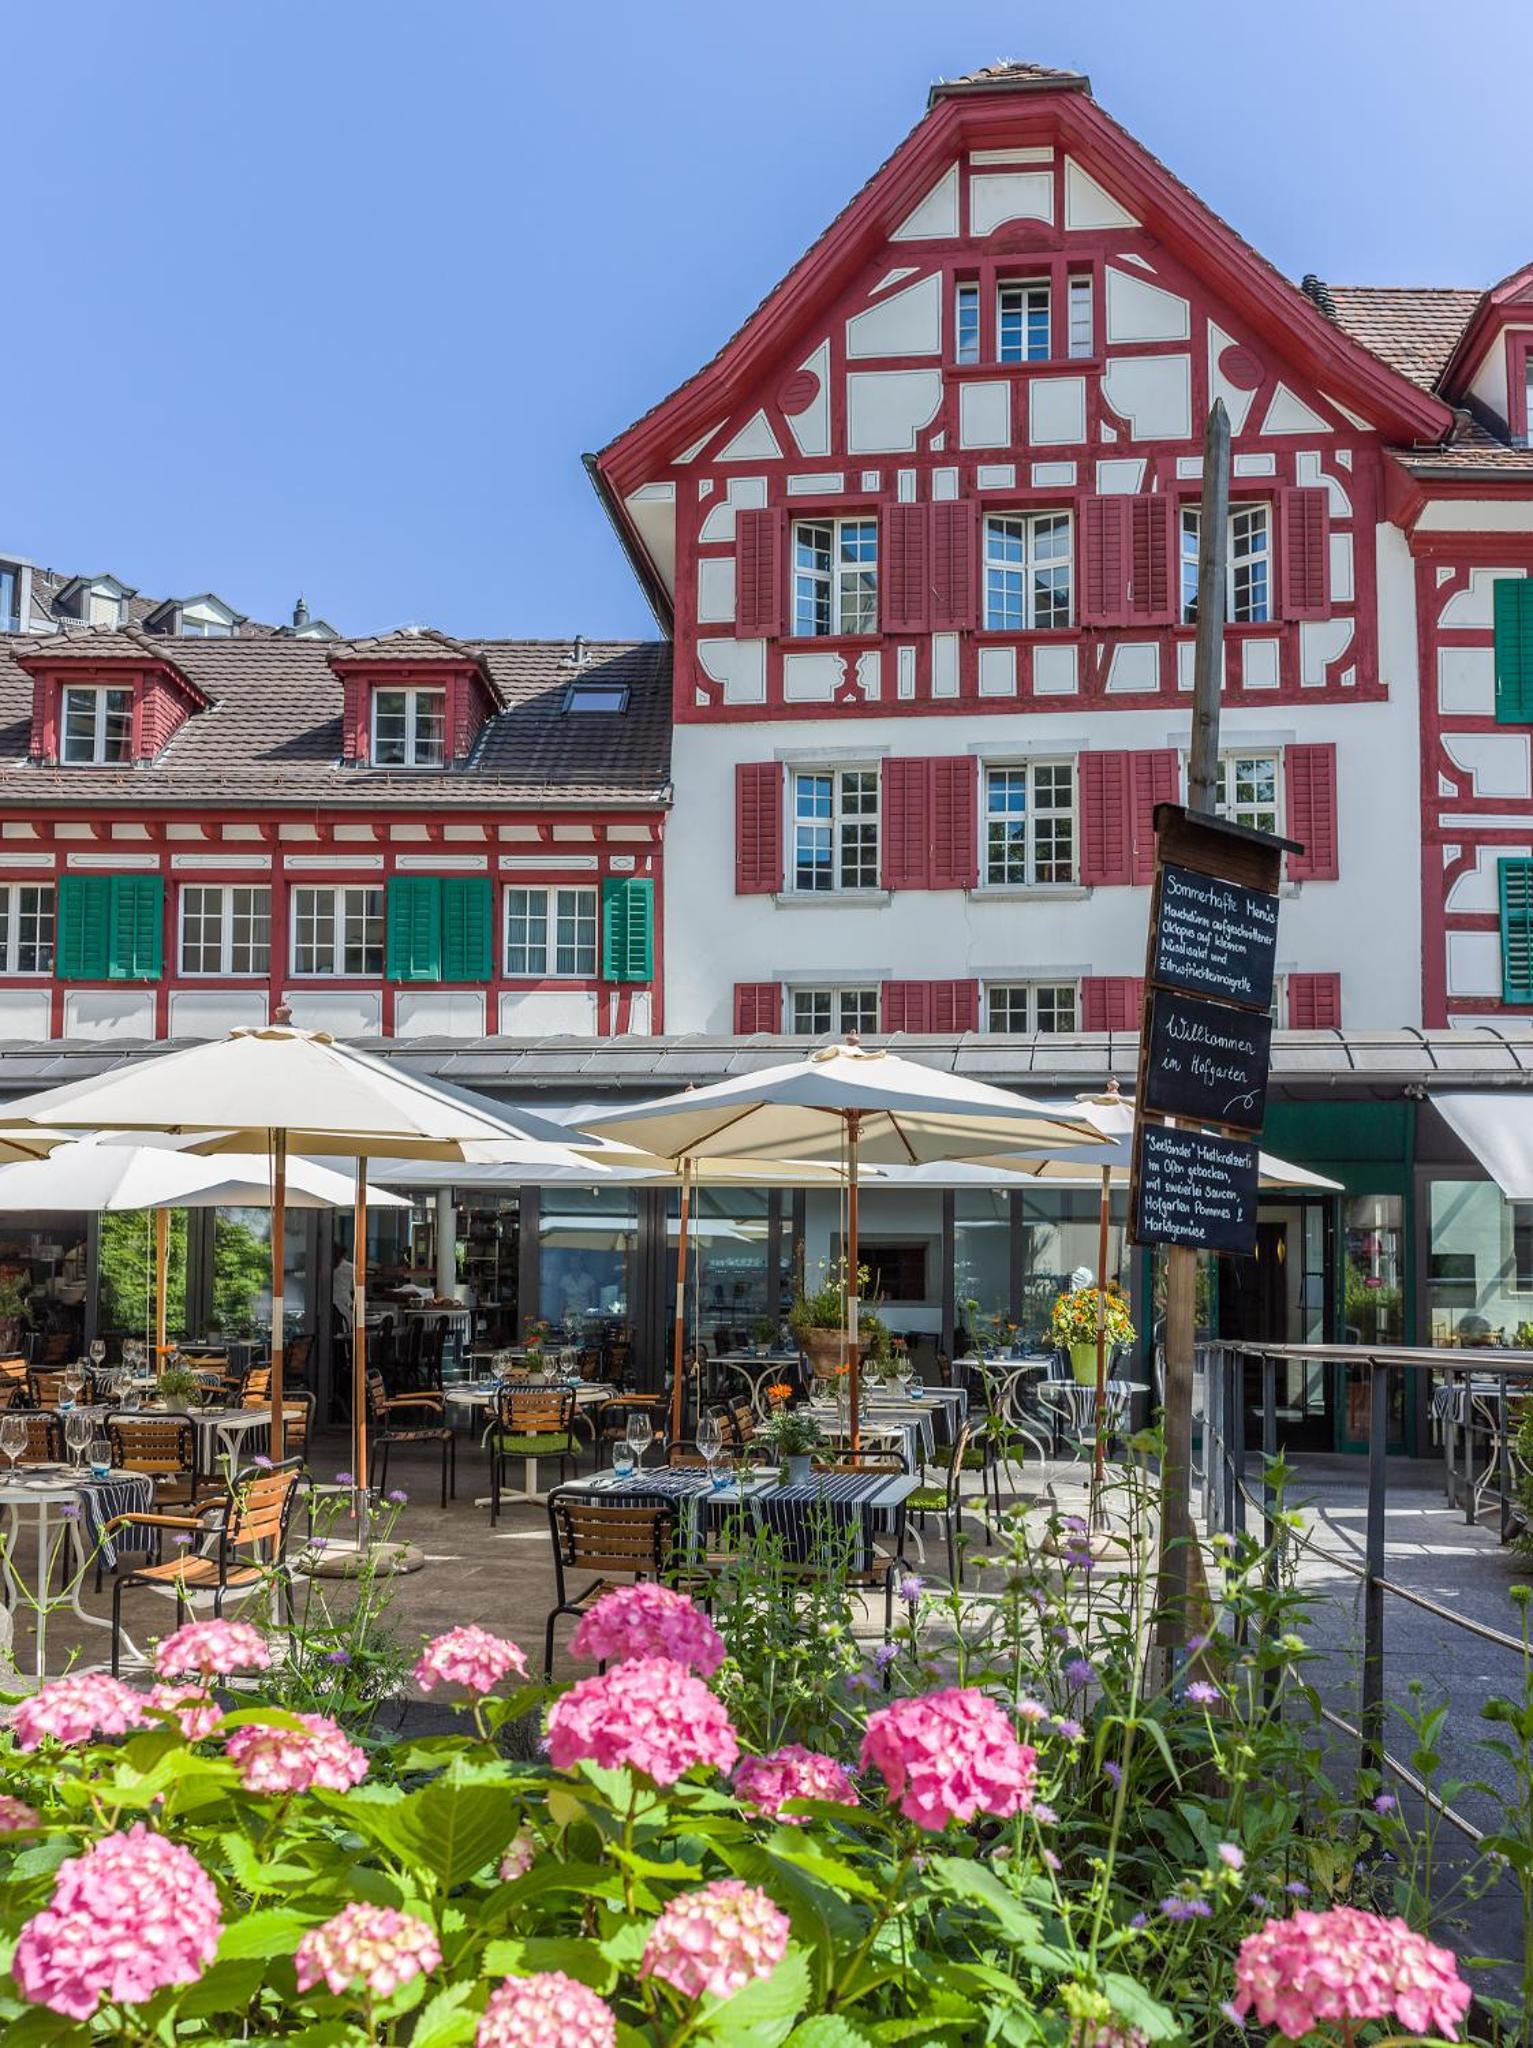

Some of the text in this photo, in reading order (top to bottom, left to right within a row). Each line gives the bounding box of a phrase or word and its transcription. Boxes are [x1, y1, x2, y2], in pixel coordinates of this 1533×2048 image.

[1167, 875, 1237, 914] Sommerhafte
[1162, 920, 1195, 943] Oktopus
[1197, 931, 1212, 946] auf
[1212, 919, 1274, 945] aufgeschnittener
[1211, 953, 1228, 965] und
[1165, 1013, 1256, 1055] Willkommen
[1191, 1054, 1247, 1087] Hofgarten
[1148, 1158, 1160, 1171] im
[1164, 1159, 1184, 1178] Ofen
[1146, 1177, 1160, 1191] mit
[1165, 1179, 1202, 1197] zweierlei
[1144, 1195, 1190, 1218] Hofgarten
[1194, 1201, 1231, 1219] Pommes
